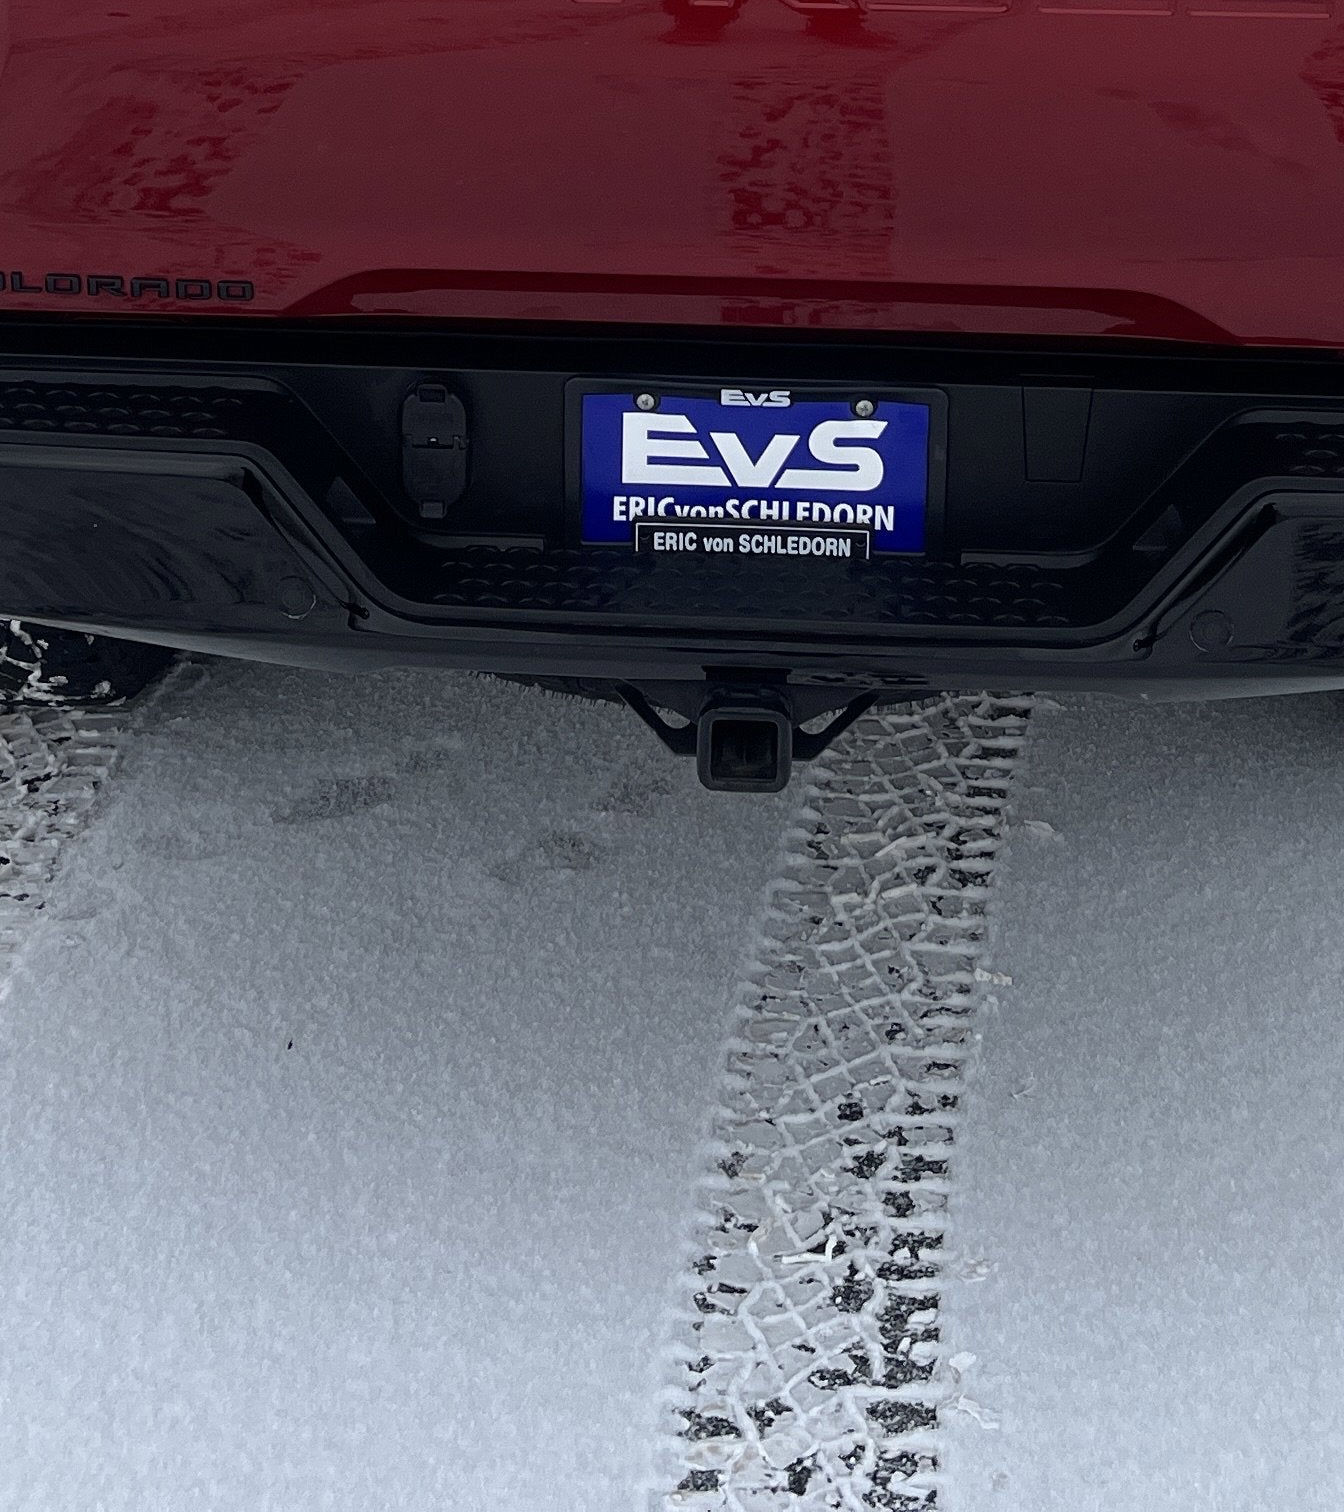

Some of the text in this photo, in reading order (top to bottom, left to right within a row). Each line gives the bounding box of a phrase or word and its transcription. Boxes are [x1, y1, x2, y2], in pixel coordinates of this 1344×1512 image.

[653, 532, 851, 557] ERIC von SCHLEDORN
